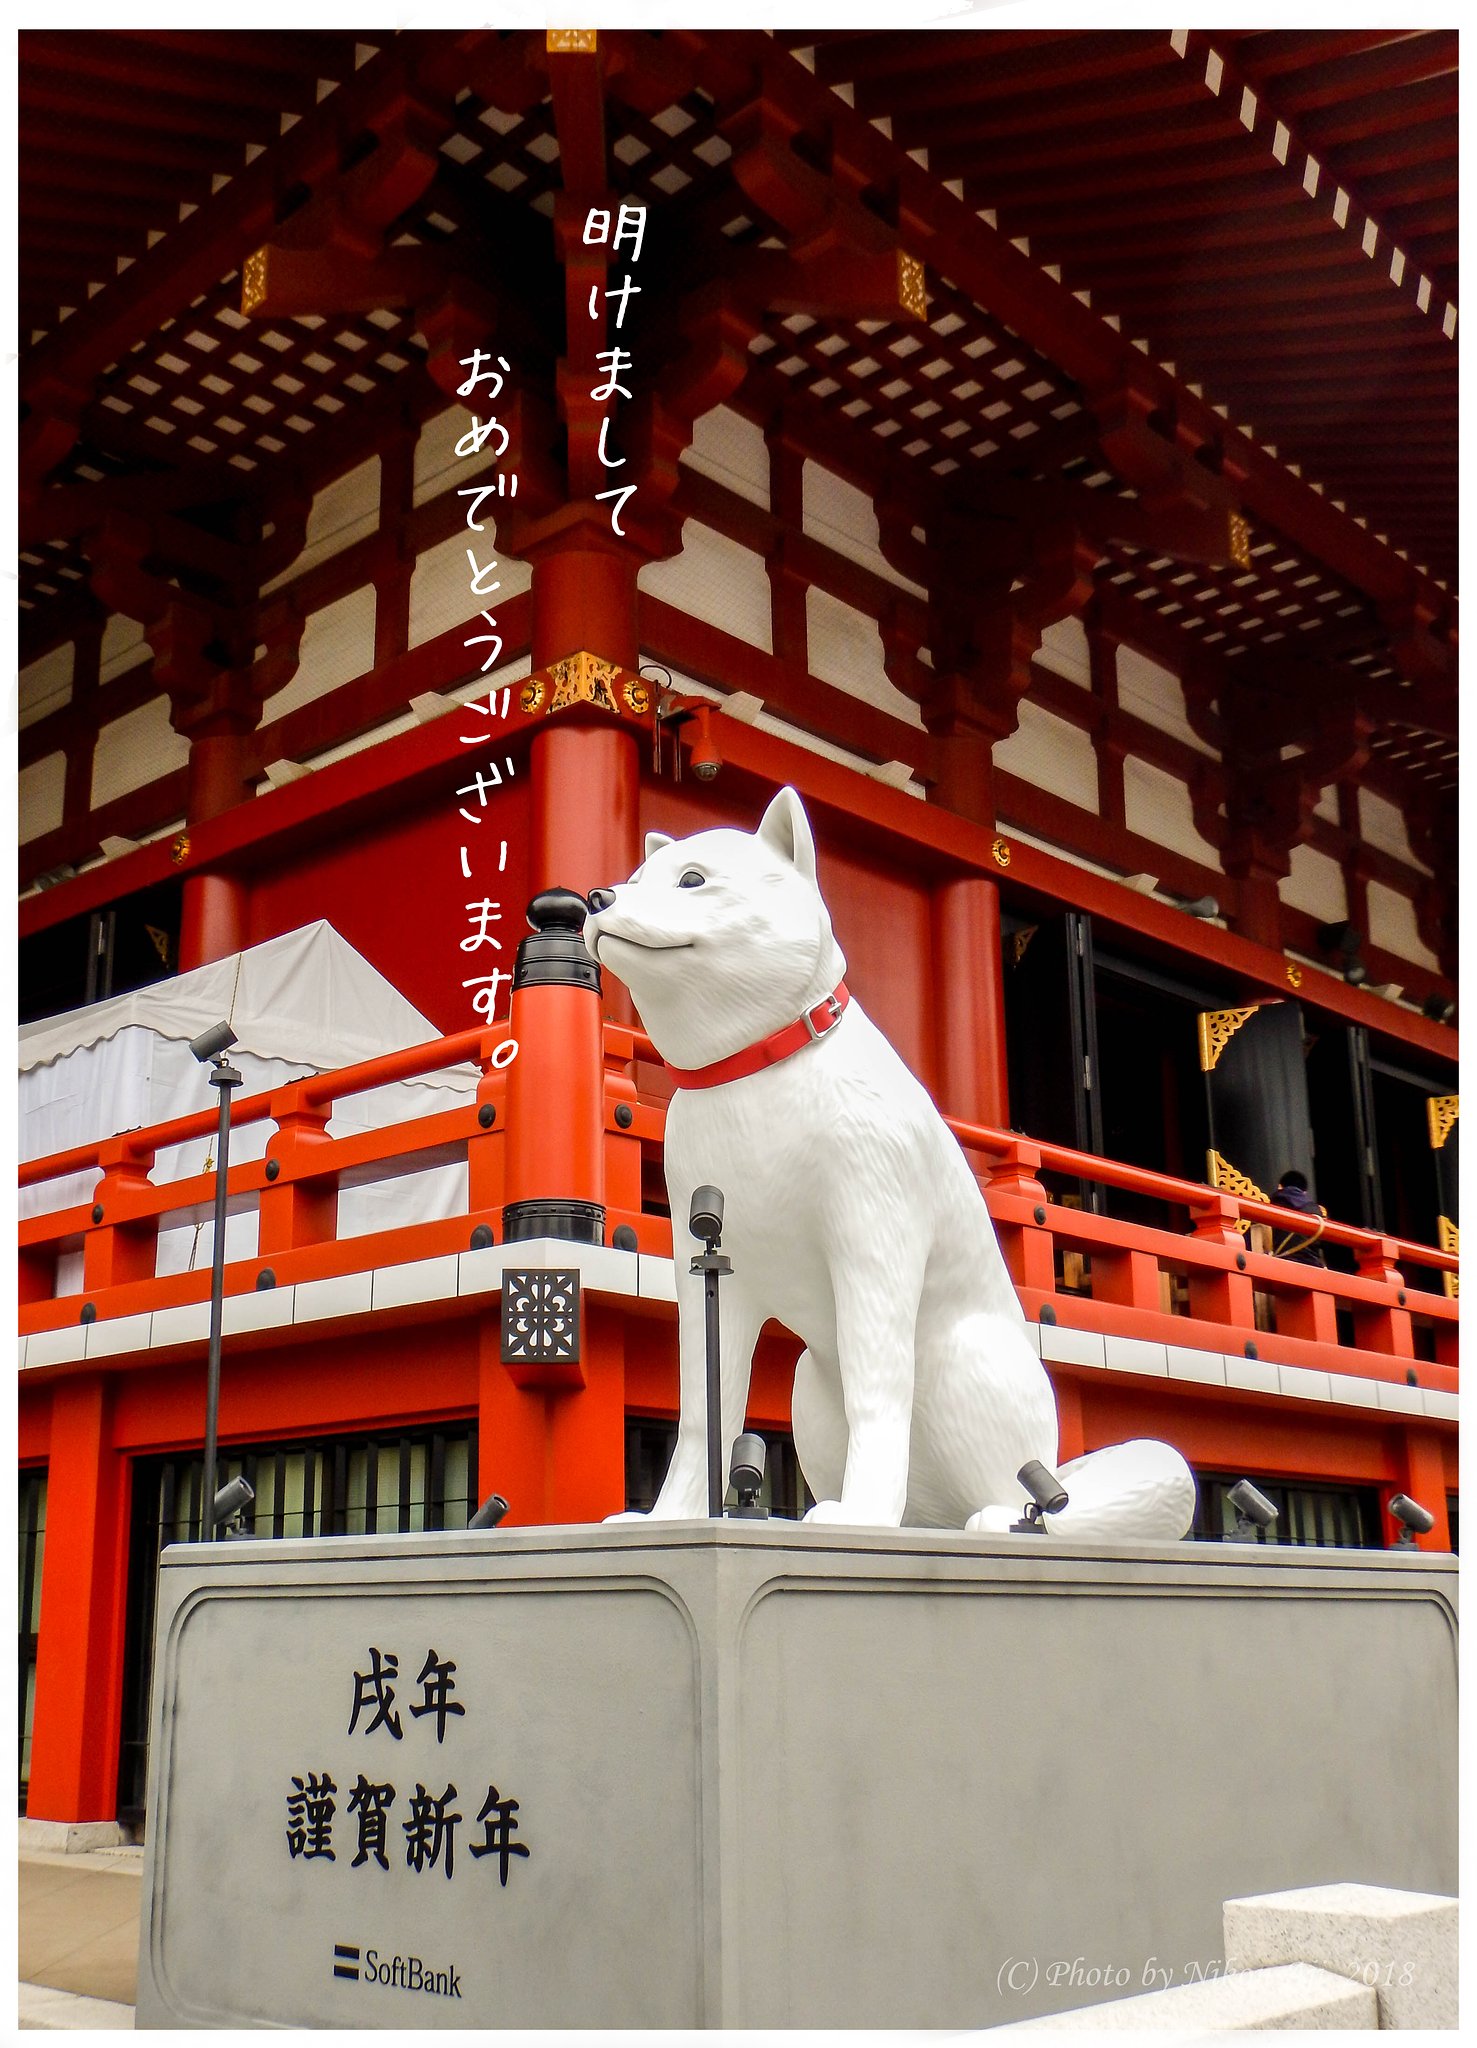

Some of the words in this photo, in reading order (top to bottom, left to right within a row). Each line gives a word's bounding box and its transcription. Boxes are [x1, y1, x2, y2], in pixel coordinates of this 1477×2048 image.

[348, 1647, 466, 1744] 戌年
[286, 1771, 531, 1887] 謹賀新年
[364, 1949, 462, 1999] SoftBank
